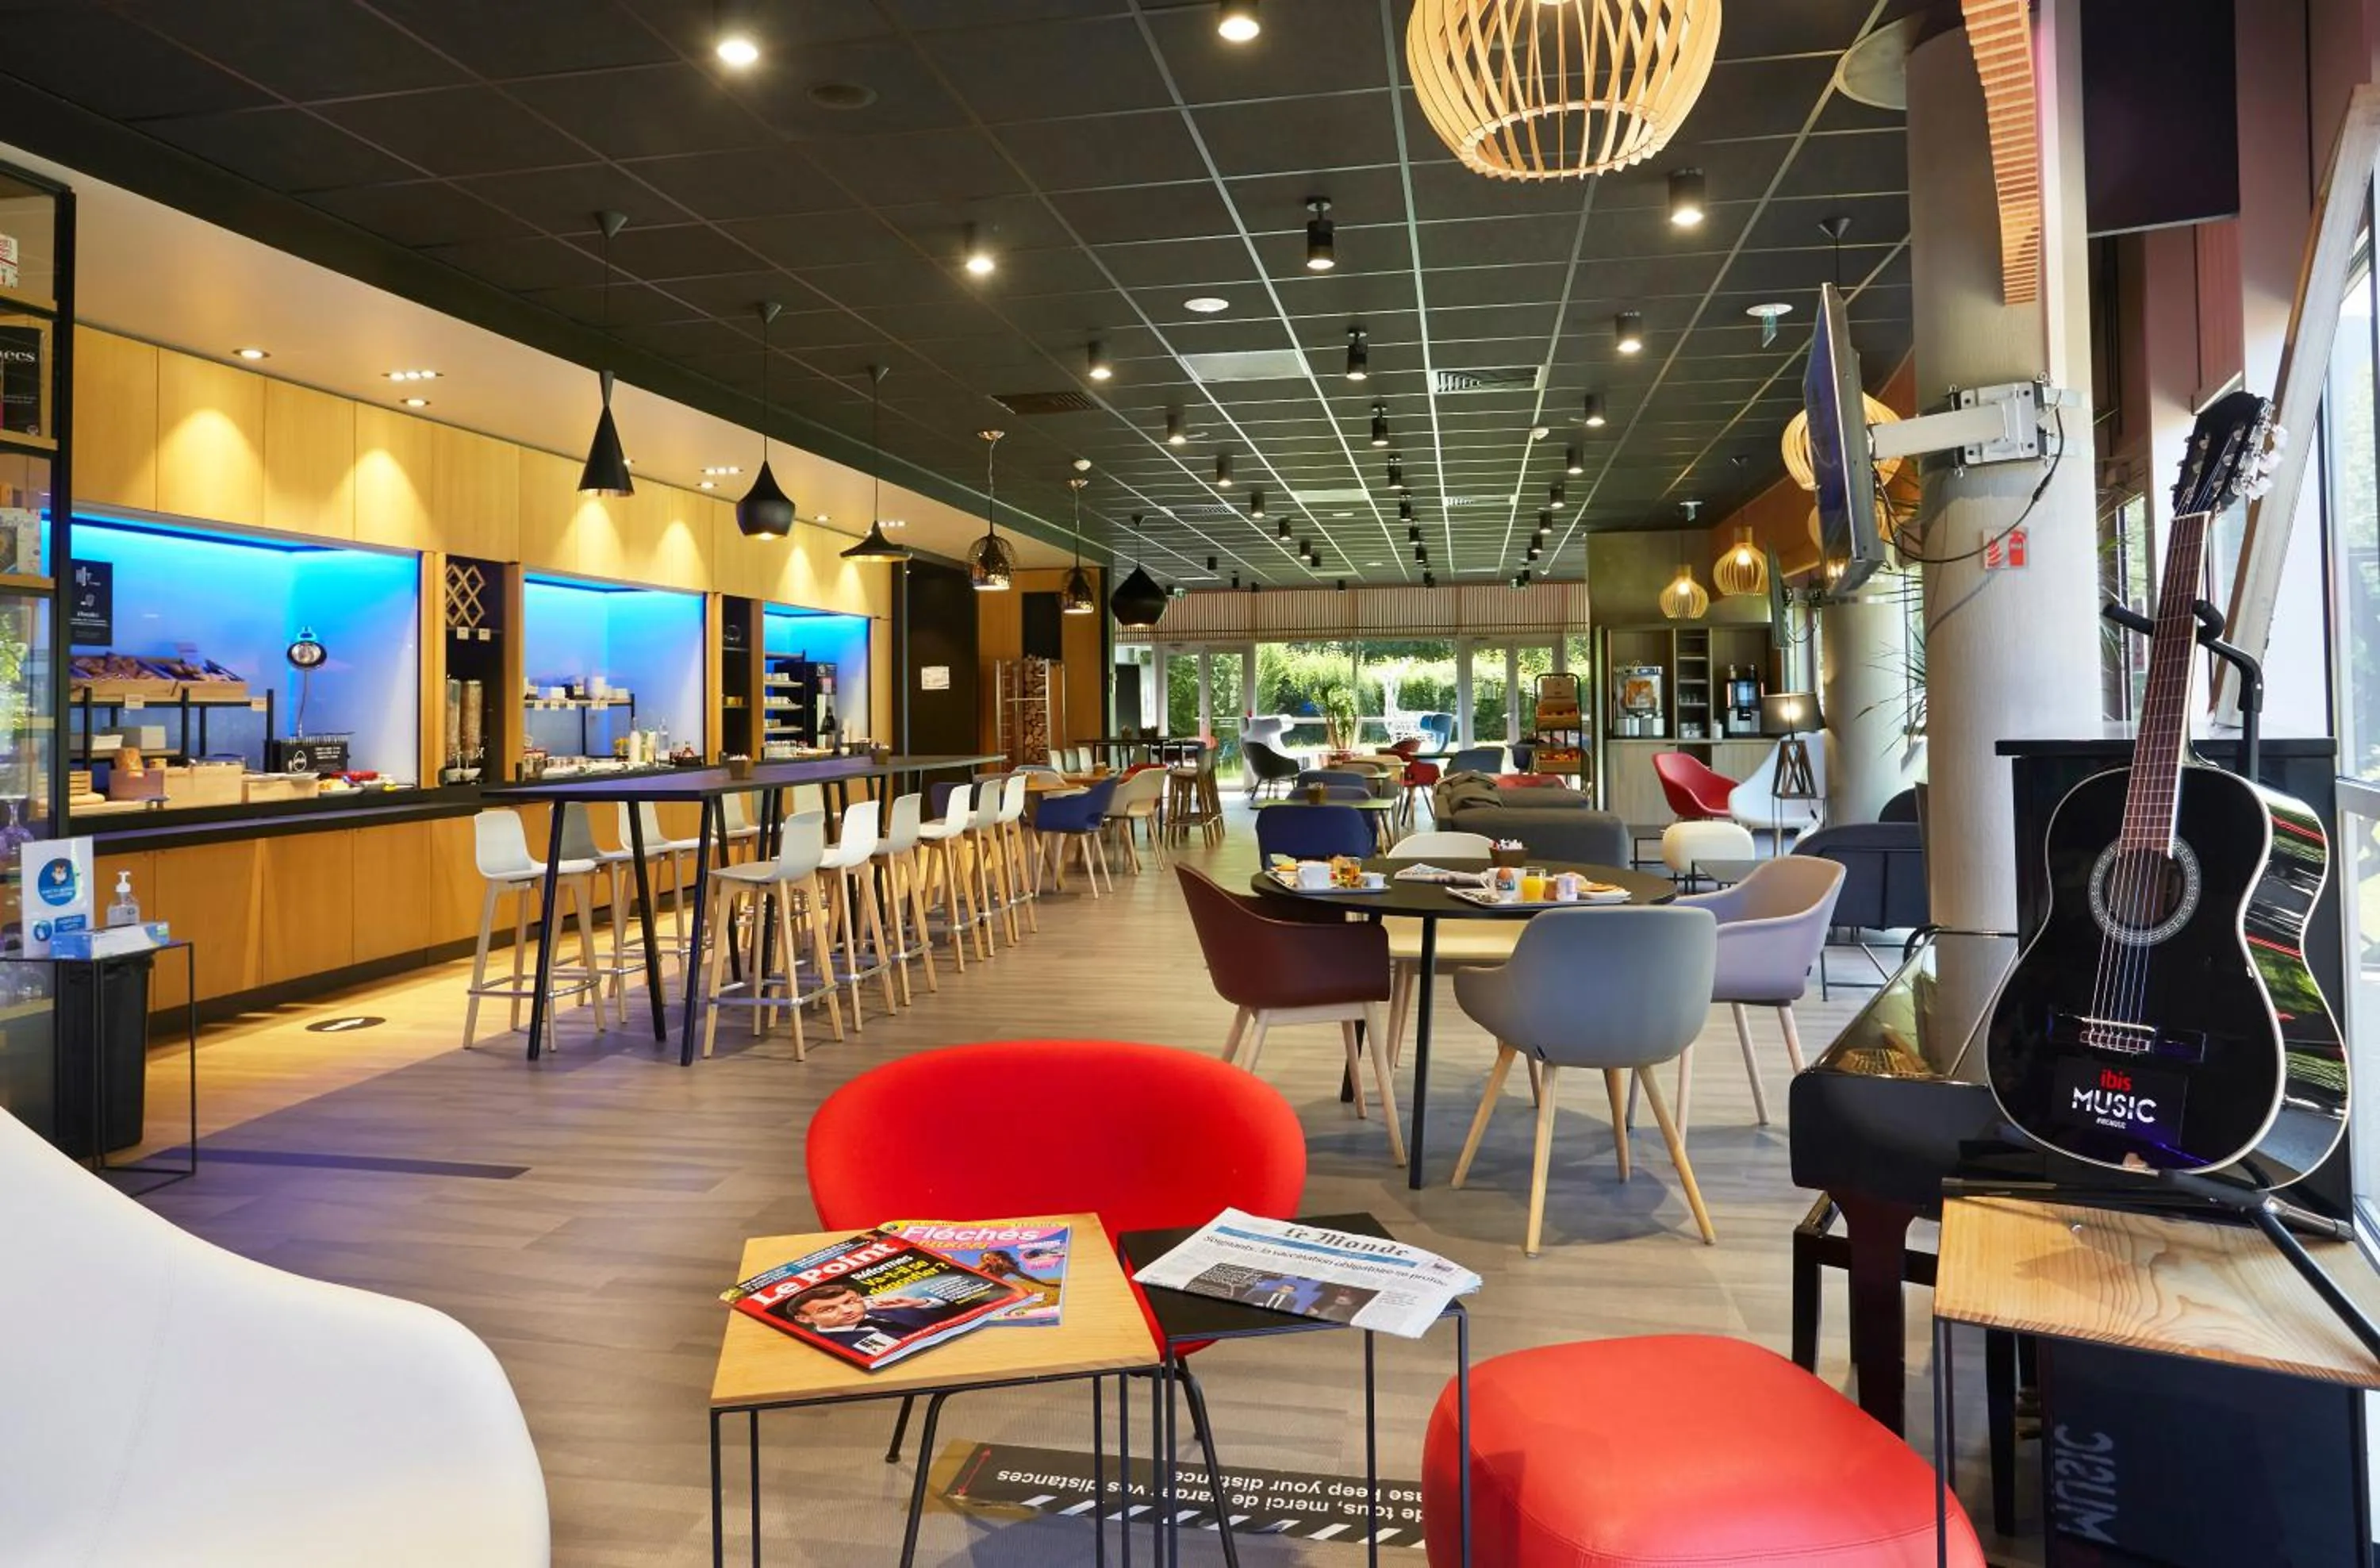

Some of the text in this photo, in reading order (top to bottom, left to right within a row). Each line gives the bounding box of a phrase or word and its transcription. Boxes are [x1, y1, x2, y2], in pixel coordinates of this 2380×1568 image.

[2100, 1069, 2132, 1092] ibis
[2071, 1086, 2157, 1123] MUSIC
[1284, 1228, 1410, 1257] Le Monde
[749, 1282, 801, 1306] Le
[795, 1242, 898, 1283] Point
[996, 1470, 1096, 1493] distances
[1269, 1479, 1322, 1494] your
[1232, 1493, 1259, 1508] de
[1265, 1497, 1330, 1512] merci
